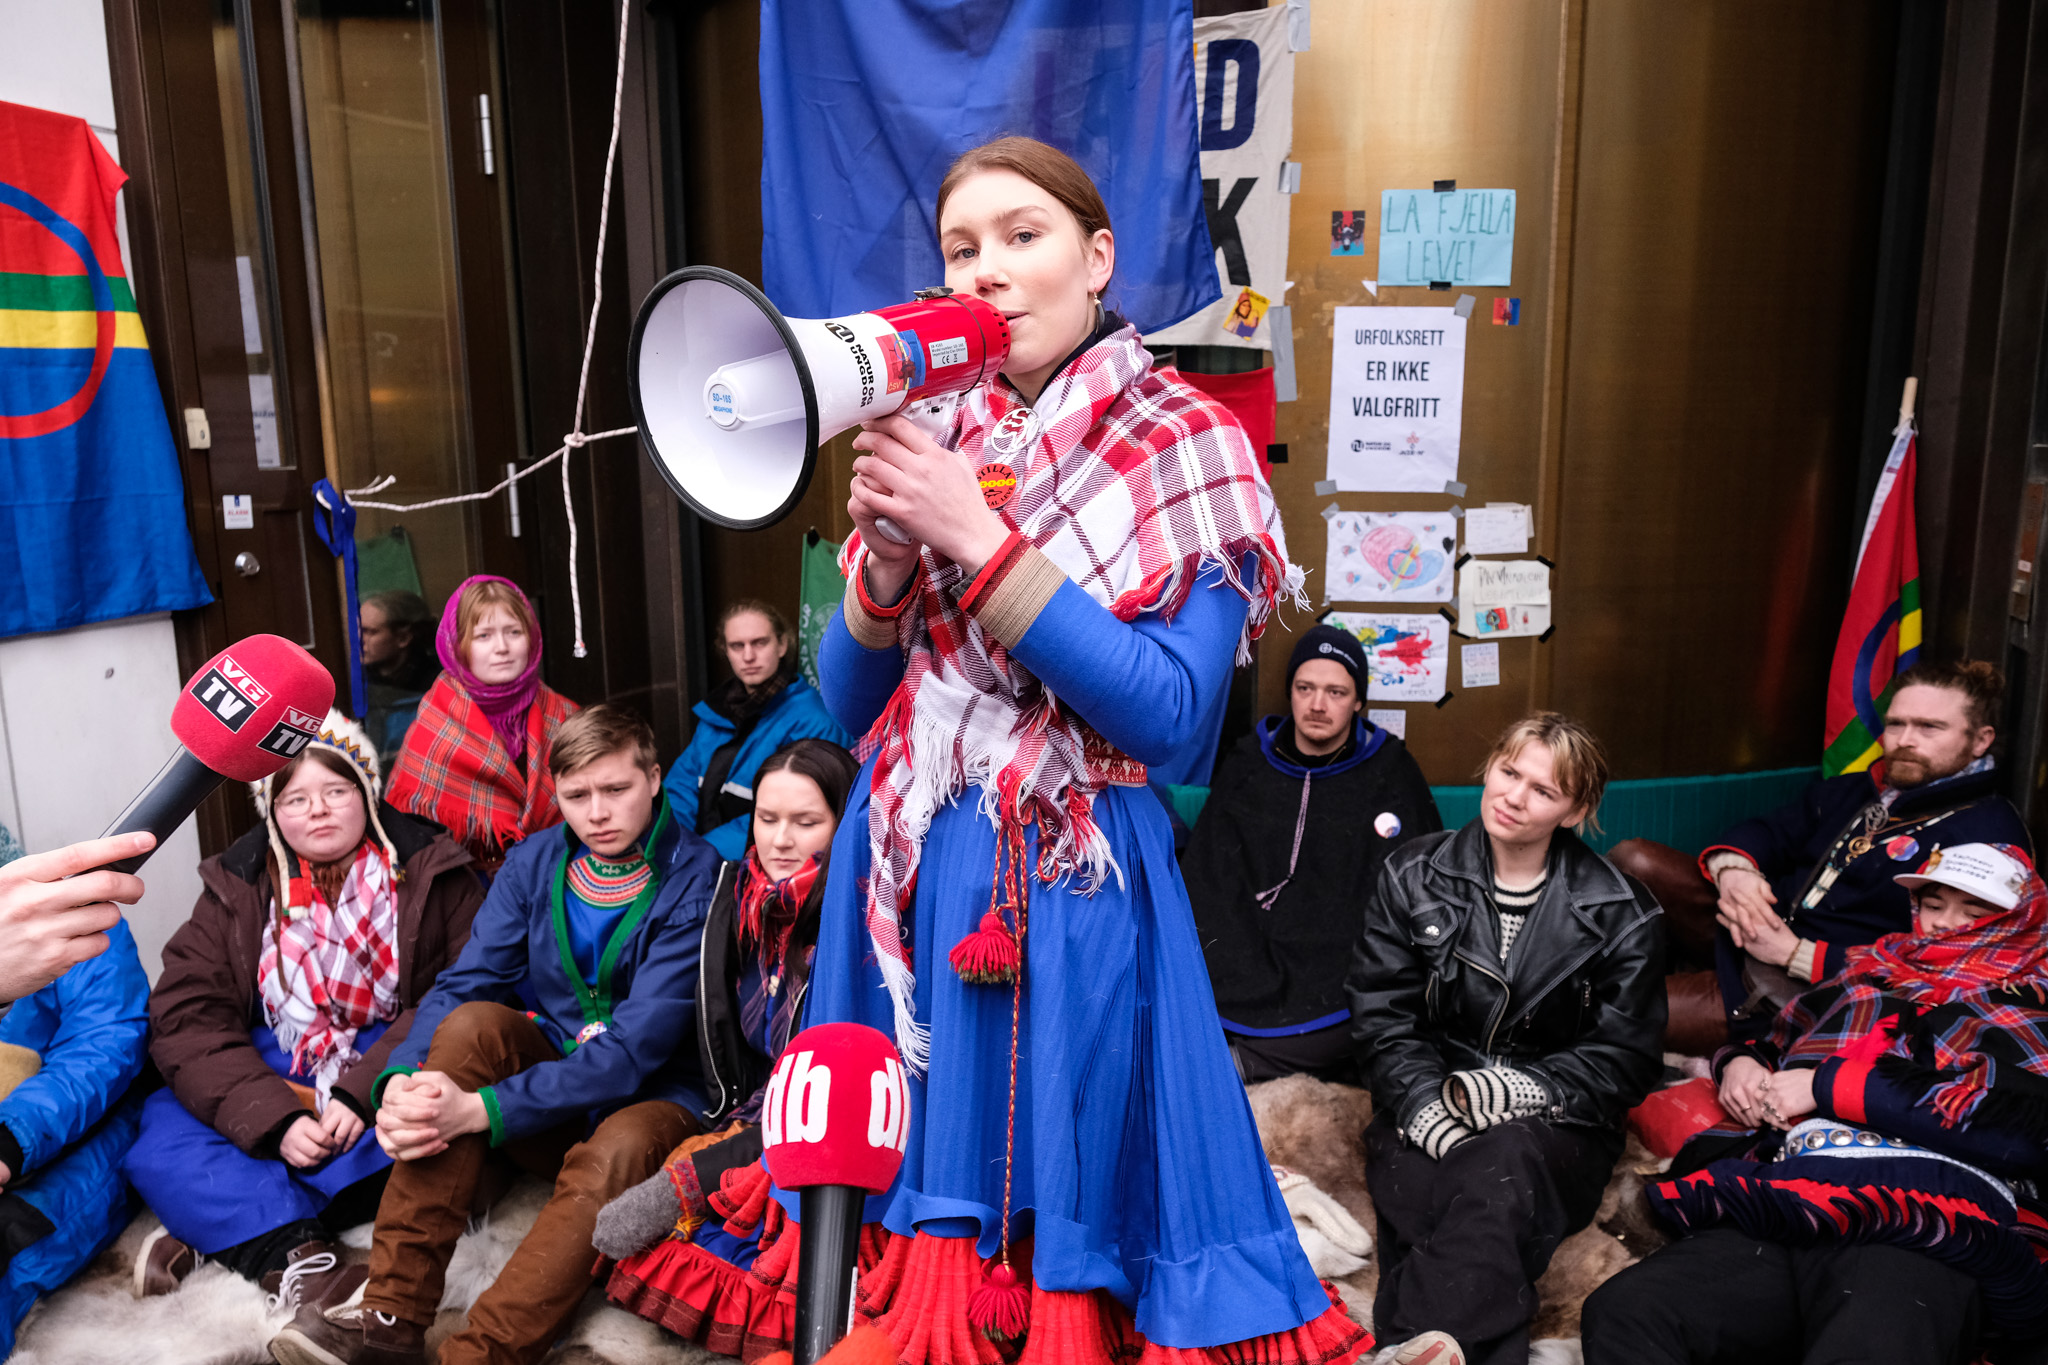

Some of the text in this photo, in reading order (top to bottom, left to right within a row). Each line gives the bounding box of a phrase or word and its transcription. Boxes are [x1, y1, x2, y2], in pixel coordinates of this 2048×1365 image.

[1386, 194, 1421, 234] LA
[1355, 329, 1445, 346] URFOLKSRETT
[850, 346, 868, 408] UNGDOM
[855, 344, 875, 406] NATUR OG
[1366, 361, 1430, 381] ER IKKE
[1352, 397, 1441, 418] VALGFRITT
[1001, 487, 1014, 502] LEVE
[223, 658, 265, 702] VG
[201, 676, 246, 721] TV
[289, 709, 322, 732] VG
[272, 729, 309, 755] TV
[762, 1050, 831, 1150] db
